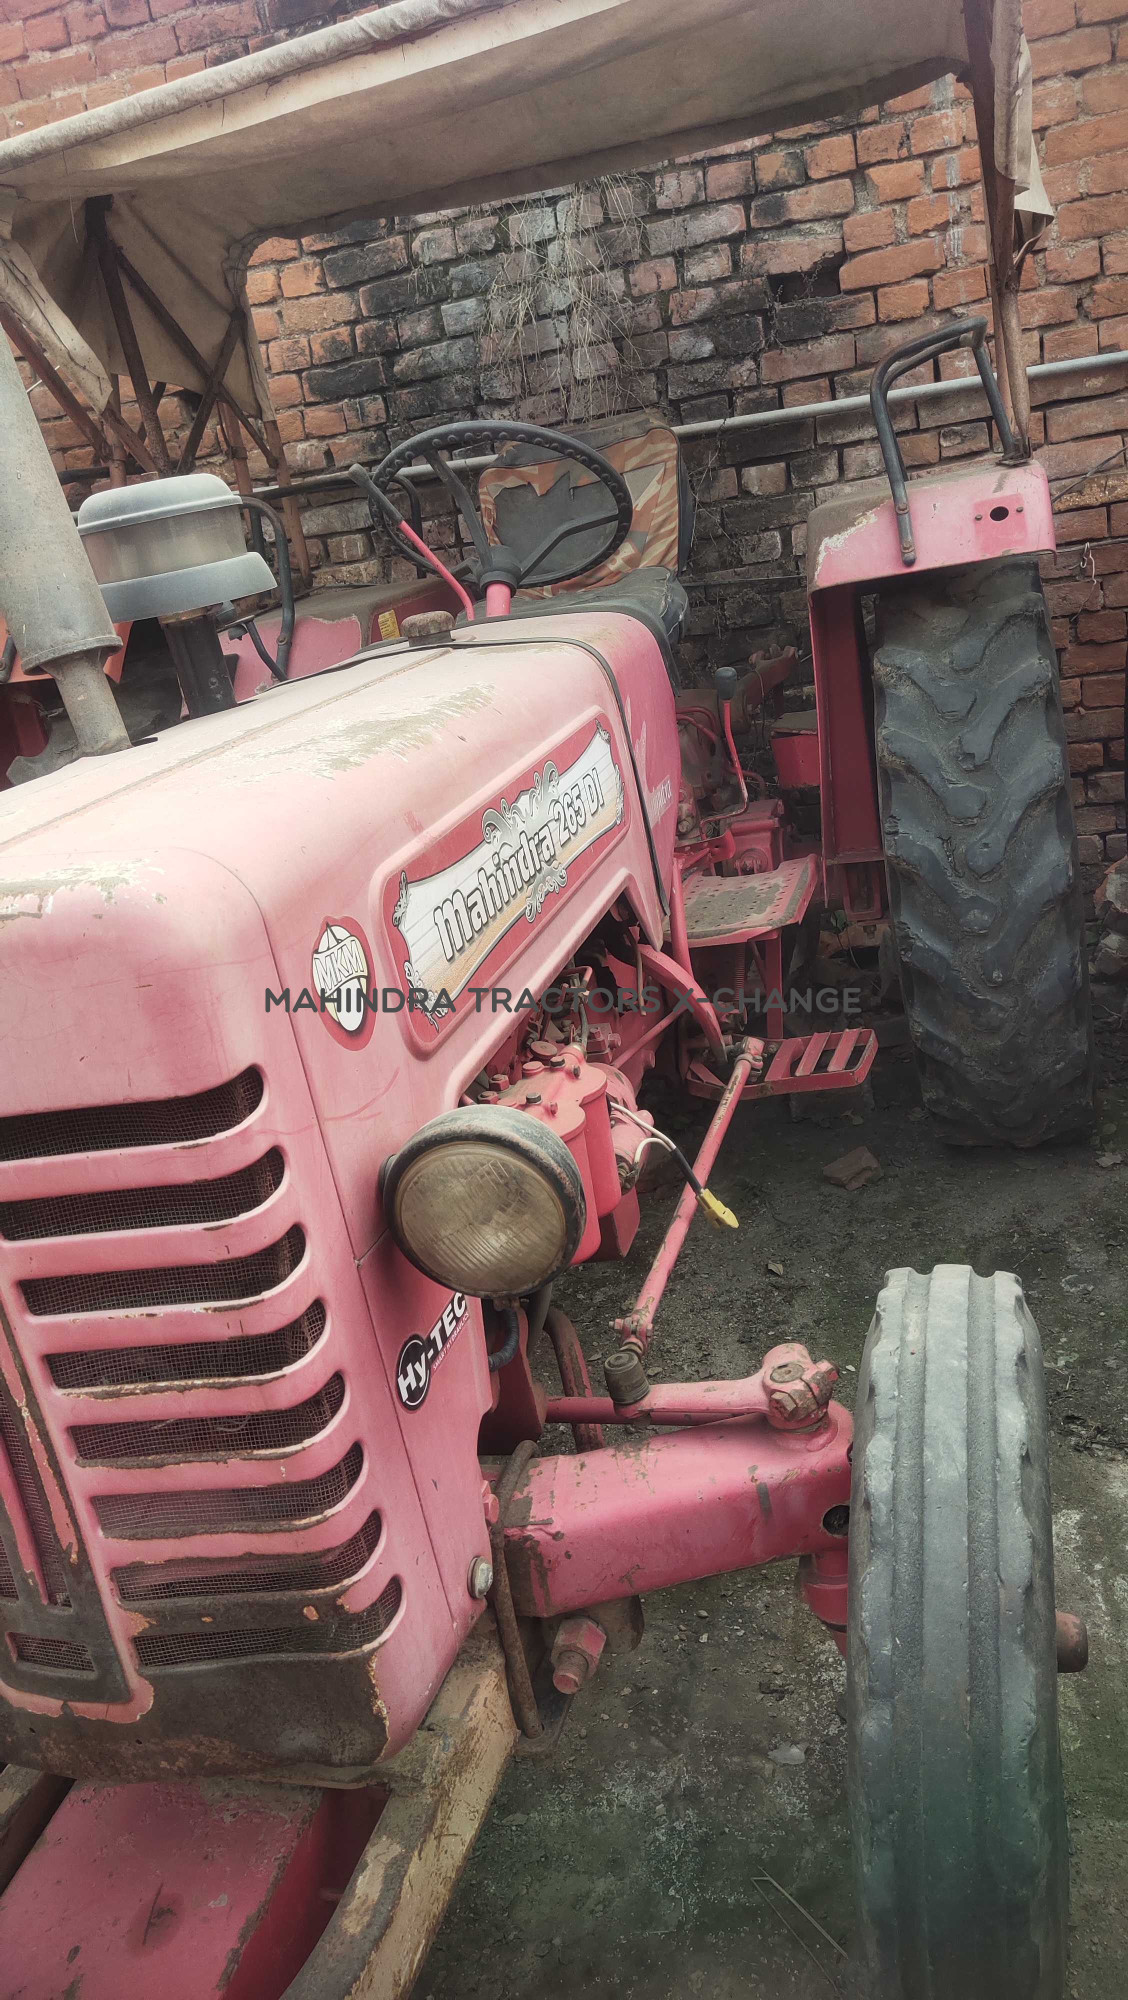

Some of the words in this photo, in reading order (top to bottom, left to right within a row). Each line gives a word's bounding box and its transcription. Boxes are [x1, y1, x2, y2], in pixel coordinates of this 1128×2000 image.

[433, 823, 556, 960] Mahindra
[553, 783, 586, 847] 265
[583, 767, 604, 817] DI
[314, 940, 364, 993] MKM
[397, 1292, 466, 1402] Hy-TEC
